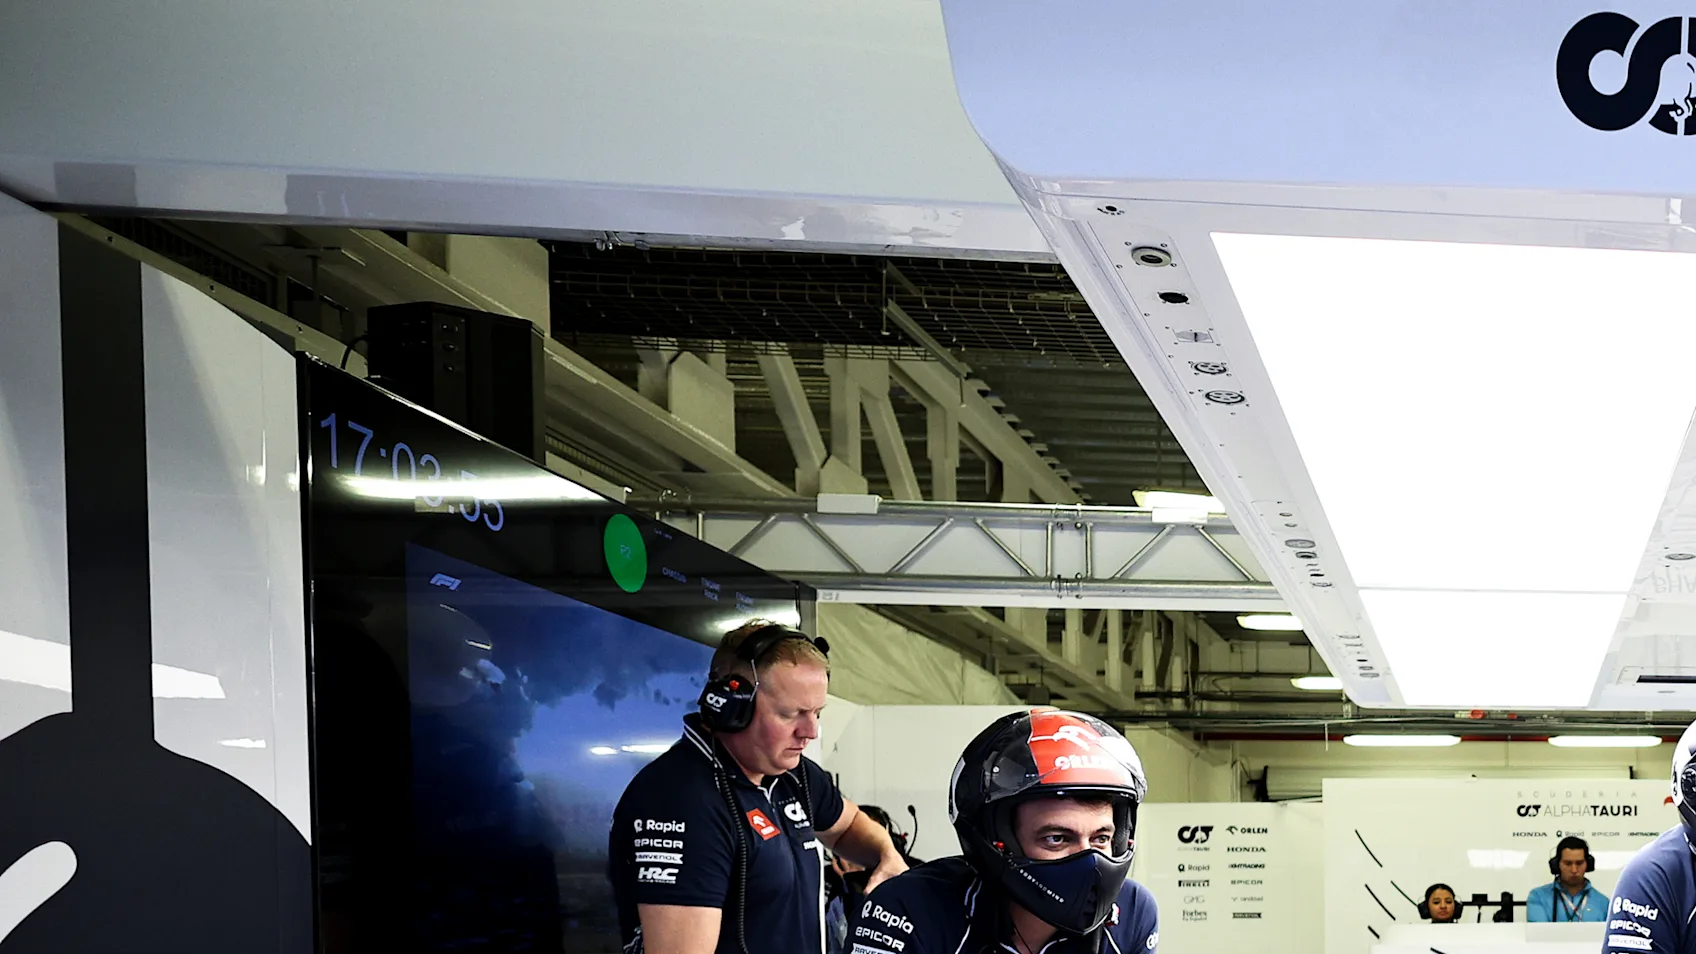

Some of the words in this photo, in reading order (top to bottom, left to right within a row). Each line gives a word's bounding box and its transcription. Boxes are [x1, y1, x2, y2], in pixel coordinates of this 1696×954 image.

[1543, 805, 1638, 817] ALPHATAURI
[646, 818, 686, 834] Rapid
[1240, 827, 1268, 835] ORLEN
[638, 867, 679, 881] HRC
[1187, 864, 1210, 873] Rapid
[1182, 909, 1207, 917] Forbes
[1622, 898, 1659, 921] Rapid
[872, 904, 915, 935] Rapid
